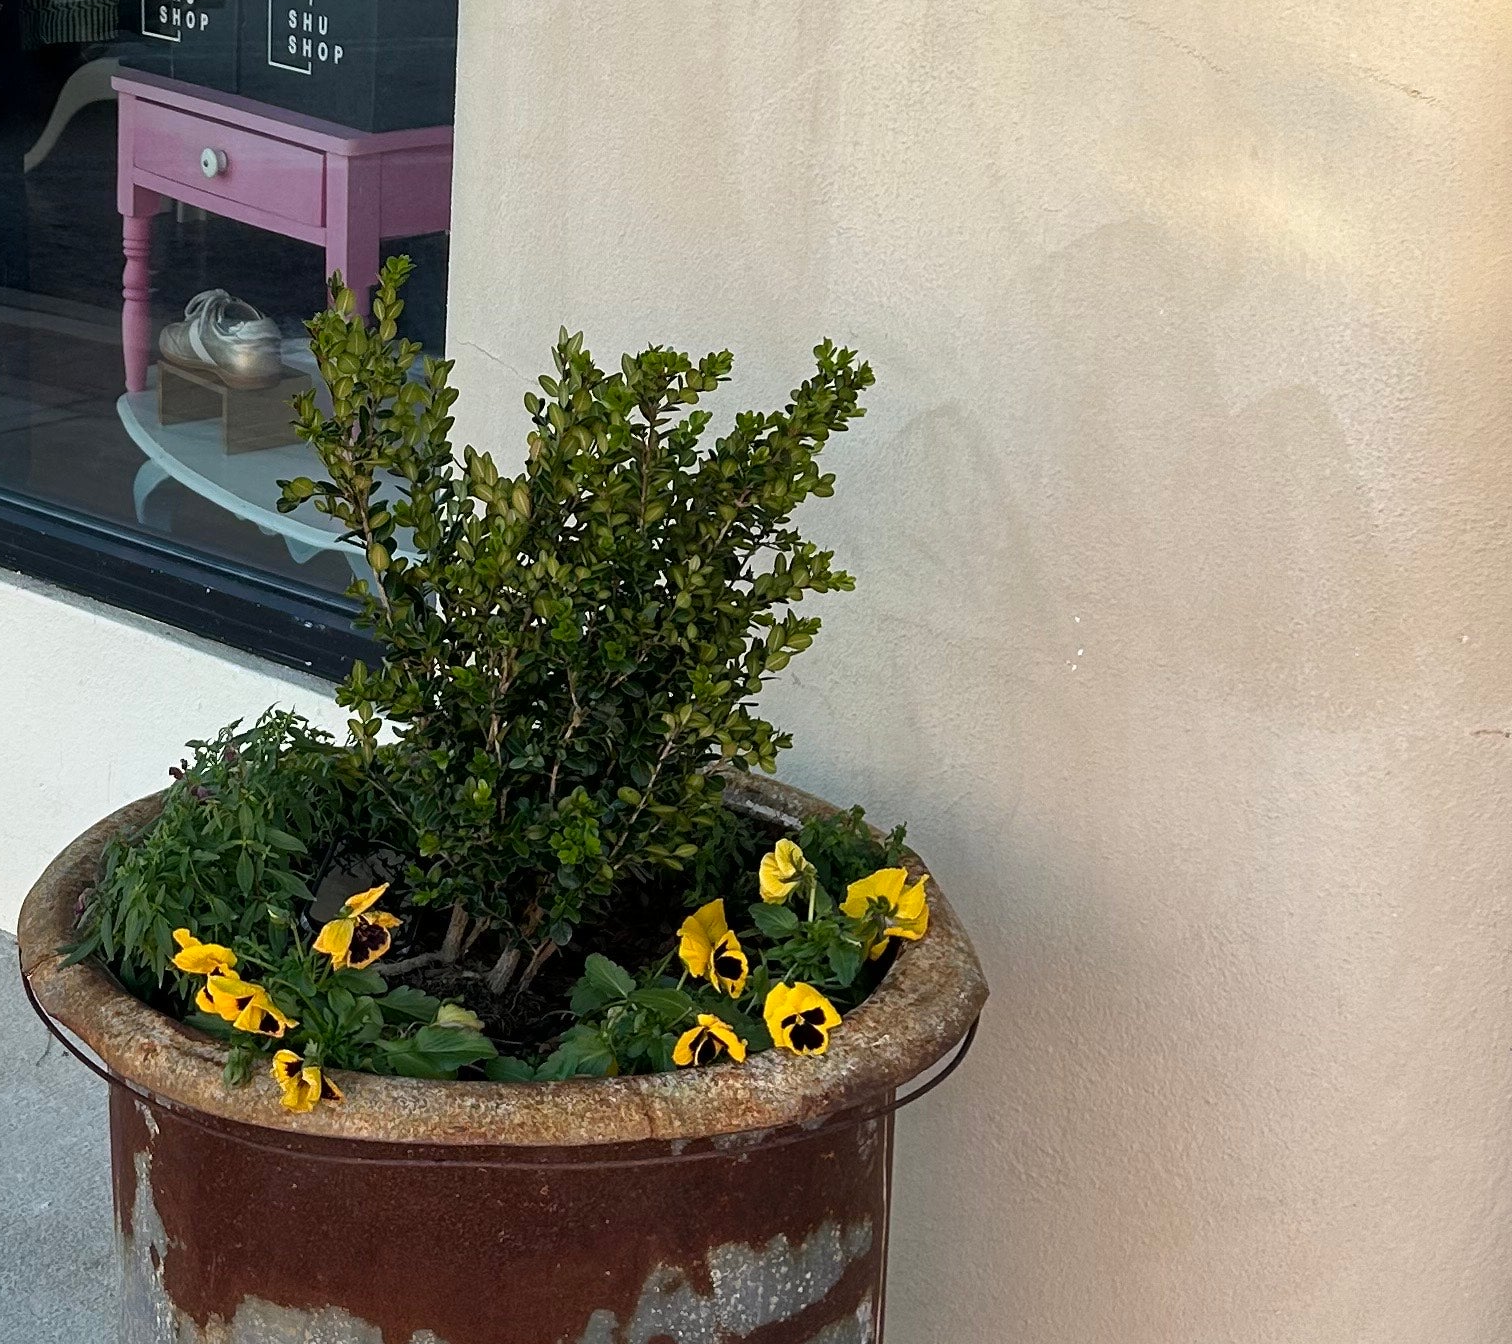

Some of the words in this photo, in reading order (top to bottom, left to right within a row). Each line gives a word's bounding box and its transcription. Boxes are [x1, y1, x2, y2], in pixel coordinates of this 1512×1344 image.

[159, 5, 209, 31] SHOP
[288, 9, 328, 36] SHU
[288, 35, 344, 65] SHOP
